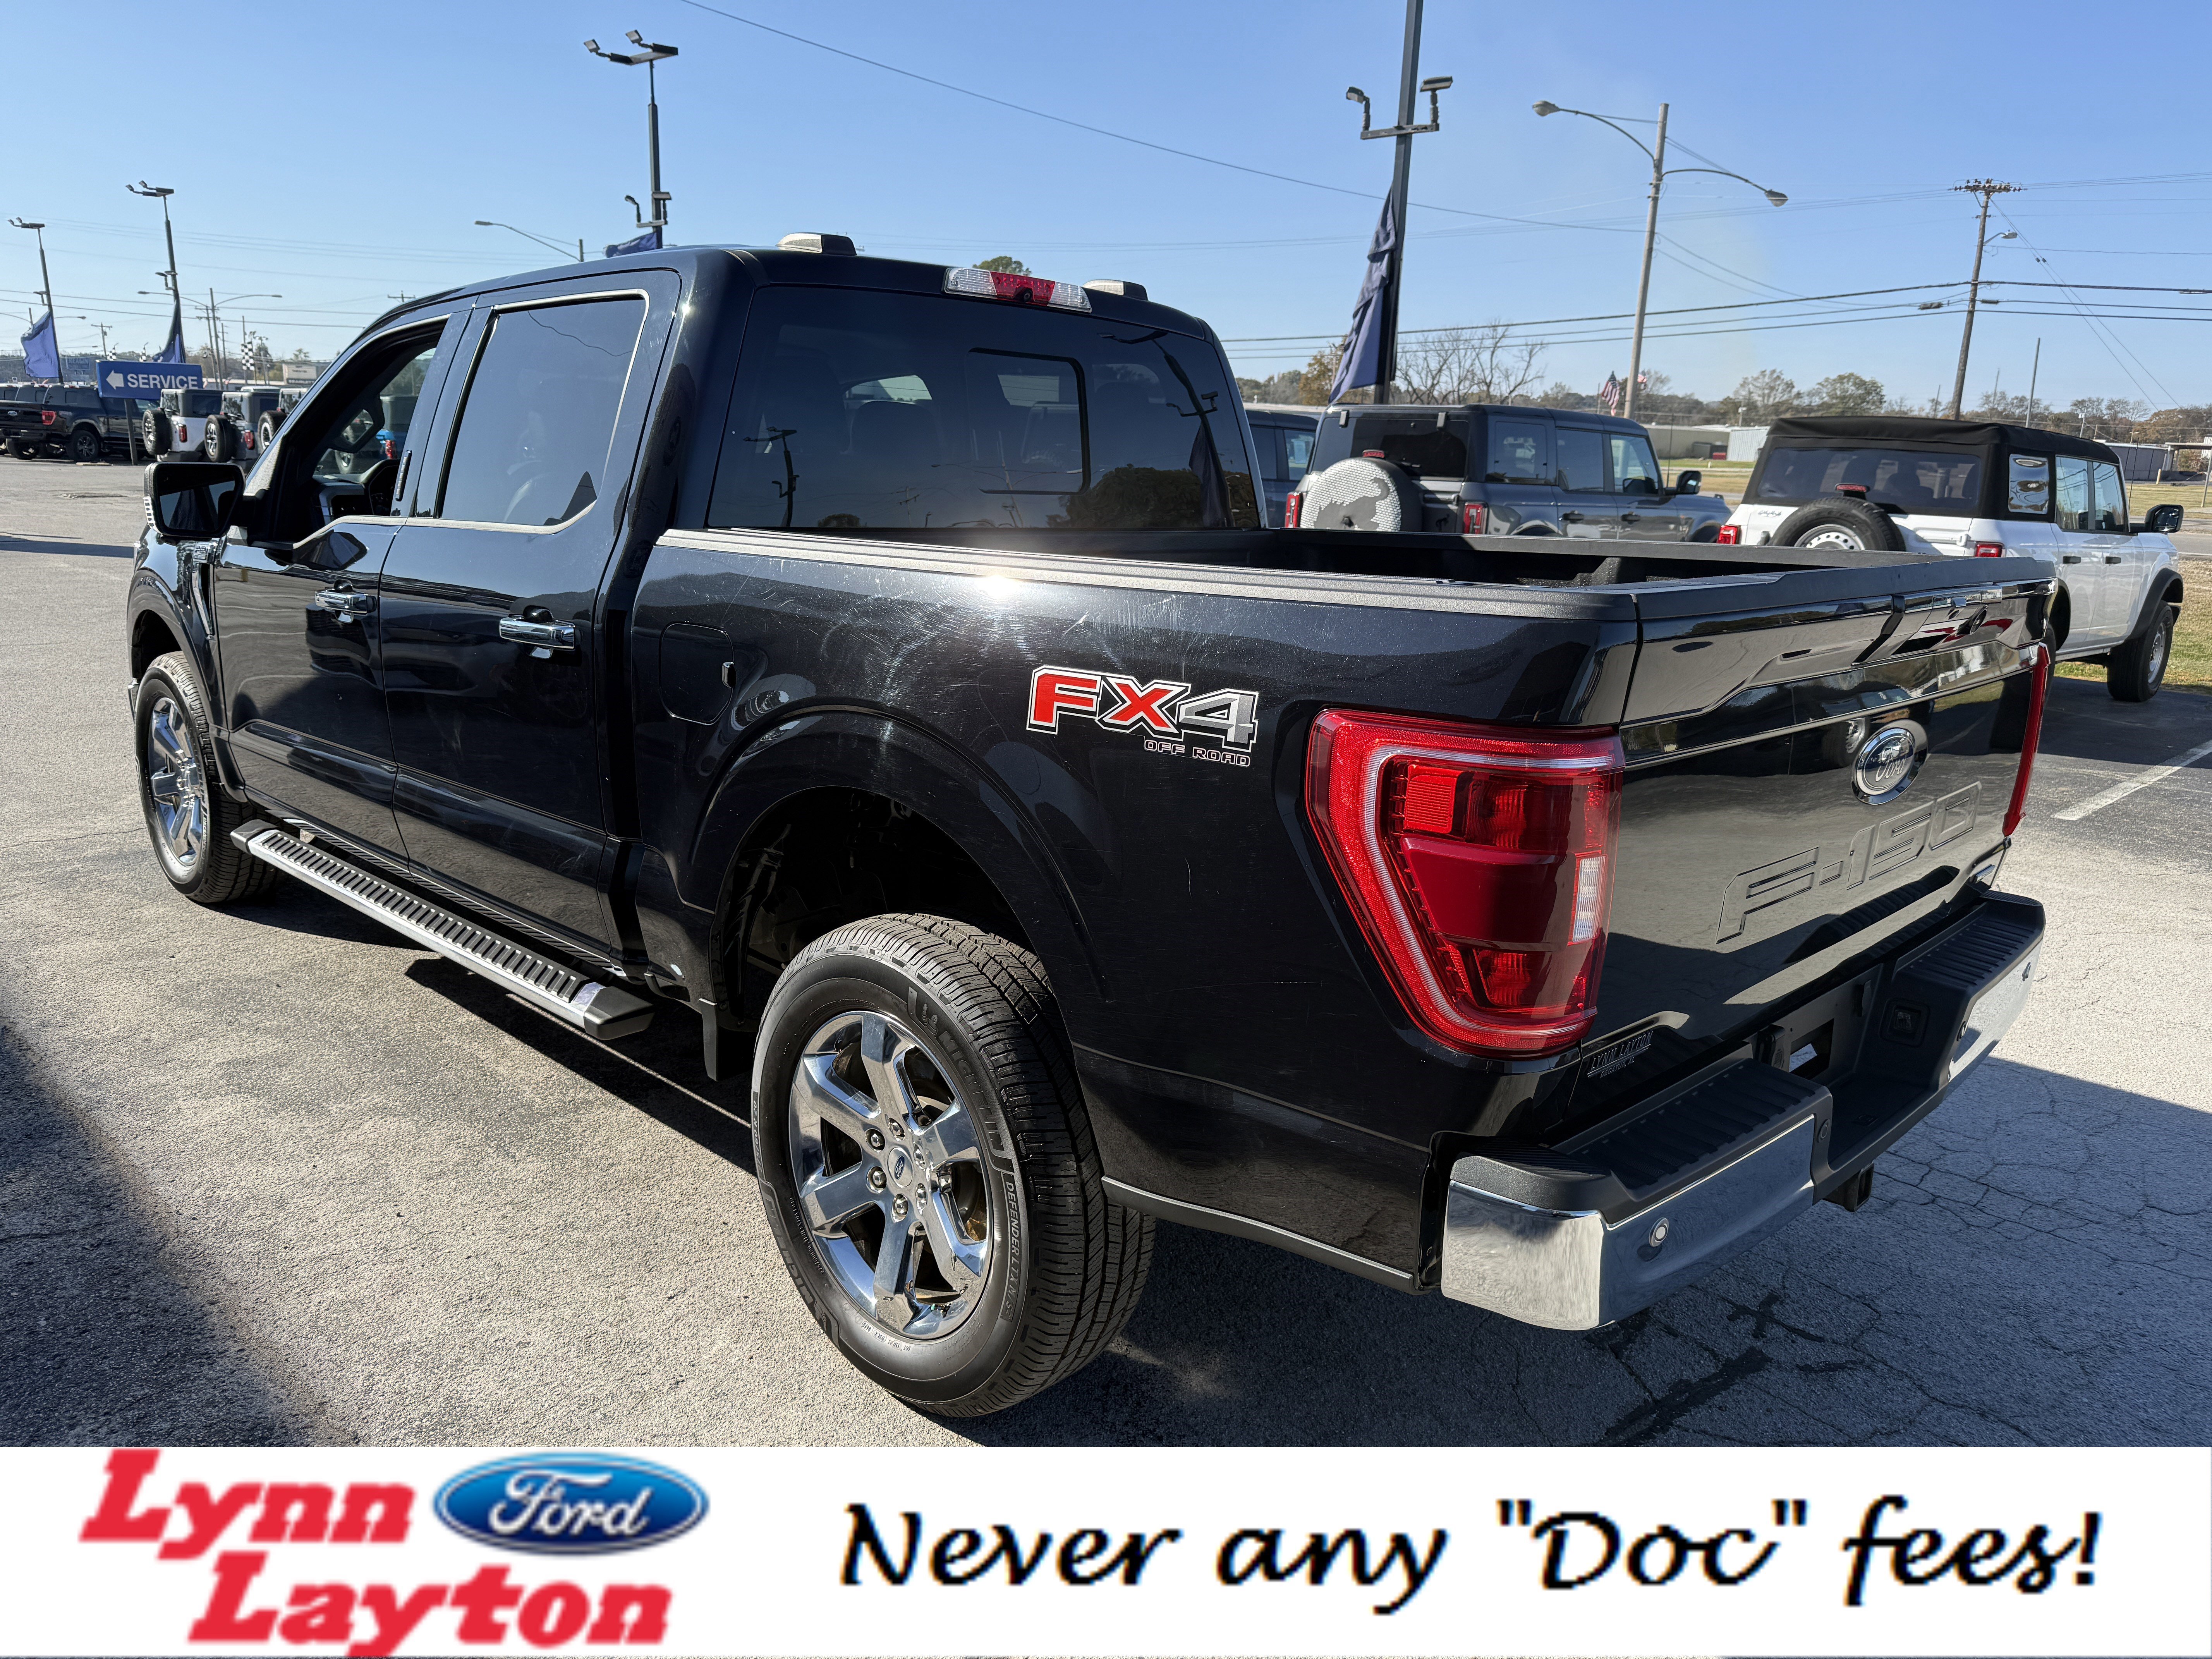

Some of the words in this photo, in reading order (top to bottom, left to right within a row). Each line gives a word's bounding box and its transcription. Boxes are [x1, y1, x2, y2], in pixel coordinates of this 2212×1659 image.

[127, 373, 198, 389] SERVICE
[1026, 665, 1259, 752] FX4
[1144, 739, 1185, 755] OFF
[1192, 746, 1251, 767] ROAD
[1875, 744, 1908, 782] Ford
[1716, 781, 1983, 945] F-150
[1591, 1048, 1617, 1070] LYNN
[1619, 1031, 1653, 1058] LAYTON
[1628, 1056, 1635, 1065] AL
[939, 1030, 1005, 1151] MICHELIN
[1006, 1181, 1020, 1256] DEFENDER
[1010, 1257, 1019, 1286] LTX
